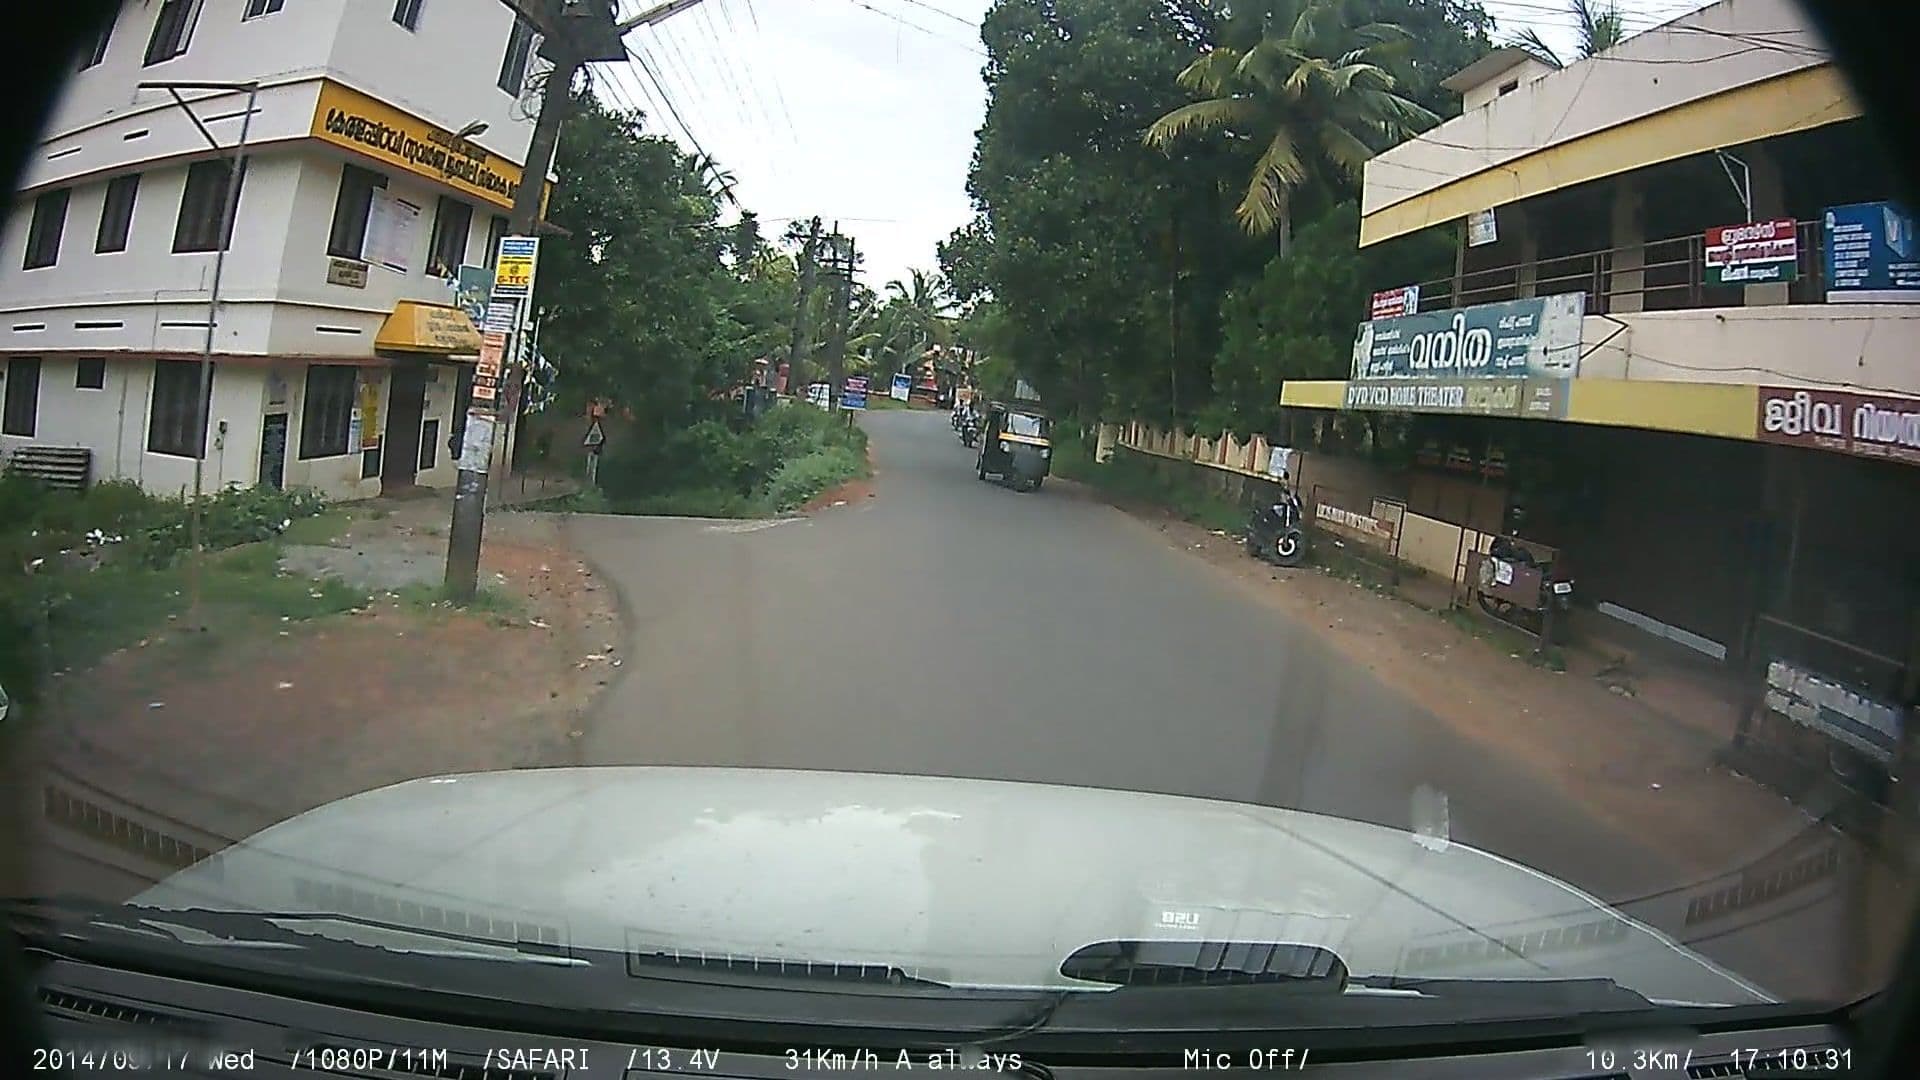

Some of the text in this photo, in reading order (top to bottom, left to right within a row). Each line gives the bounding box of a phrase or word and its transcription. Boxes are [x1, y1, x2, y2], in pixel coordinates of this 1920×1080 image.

[1409, 312, 1493, 369] വനിത
[1390, 386, 1416, 407] HOME
[1417, 386, 1464, 408] THEATER
[1764, 391, 1842, 435] ജീവ
